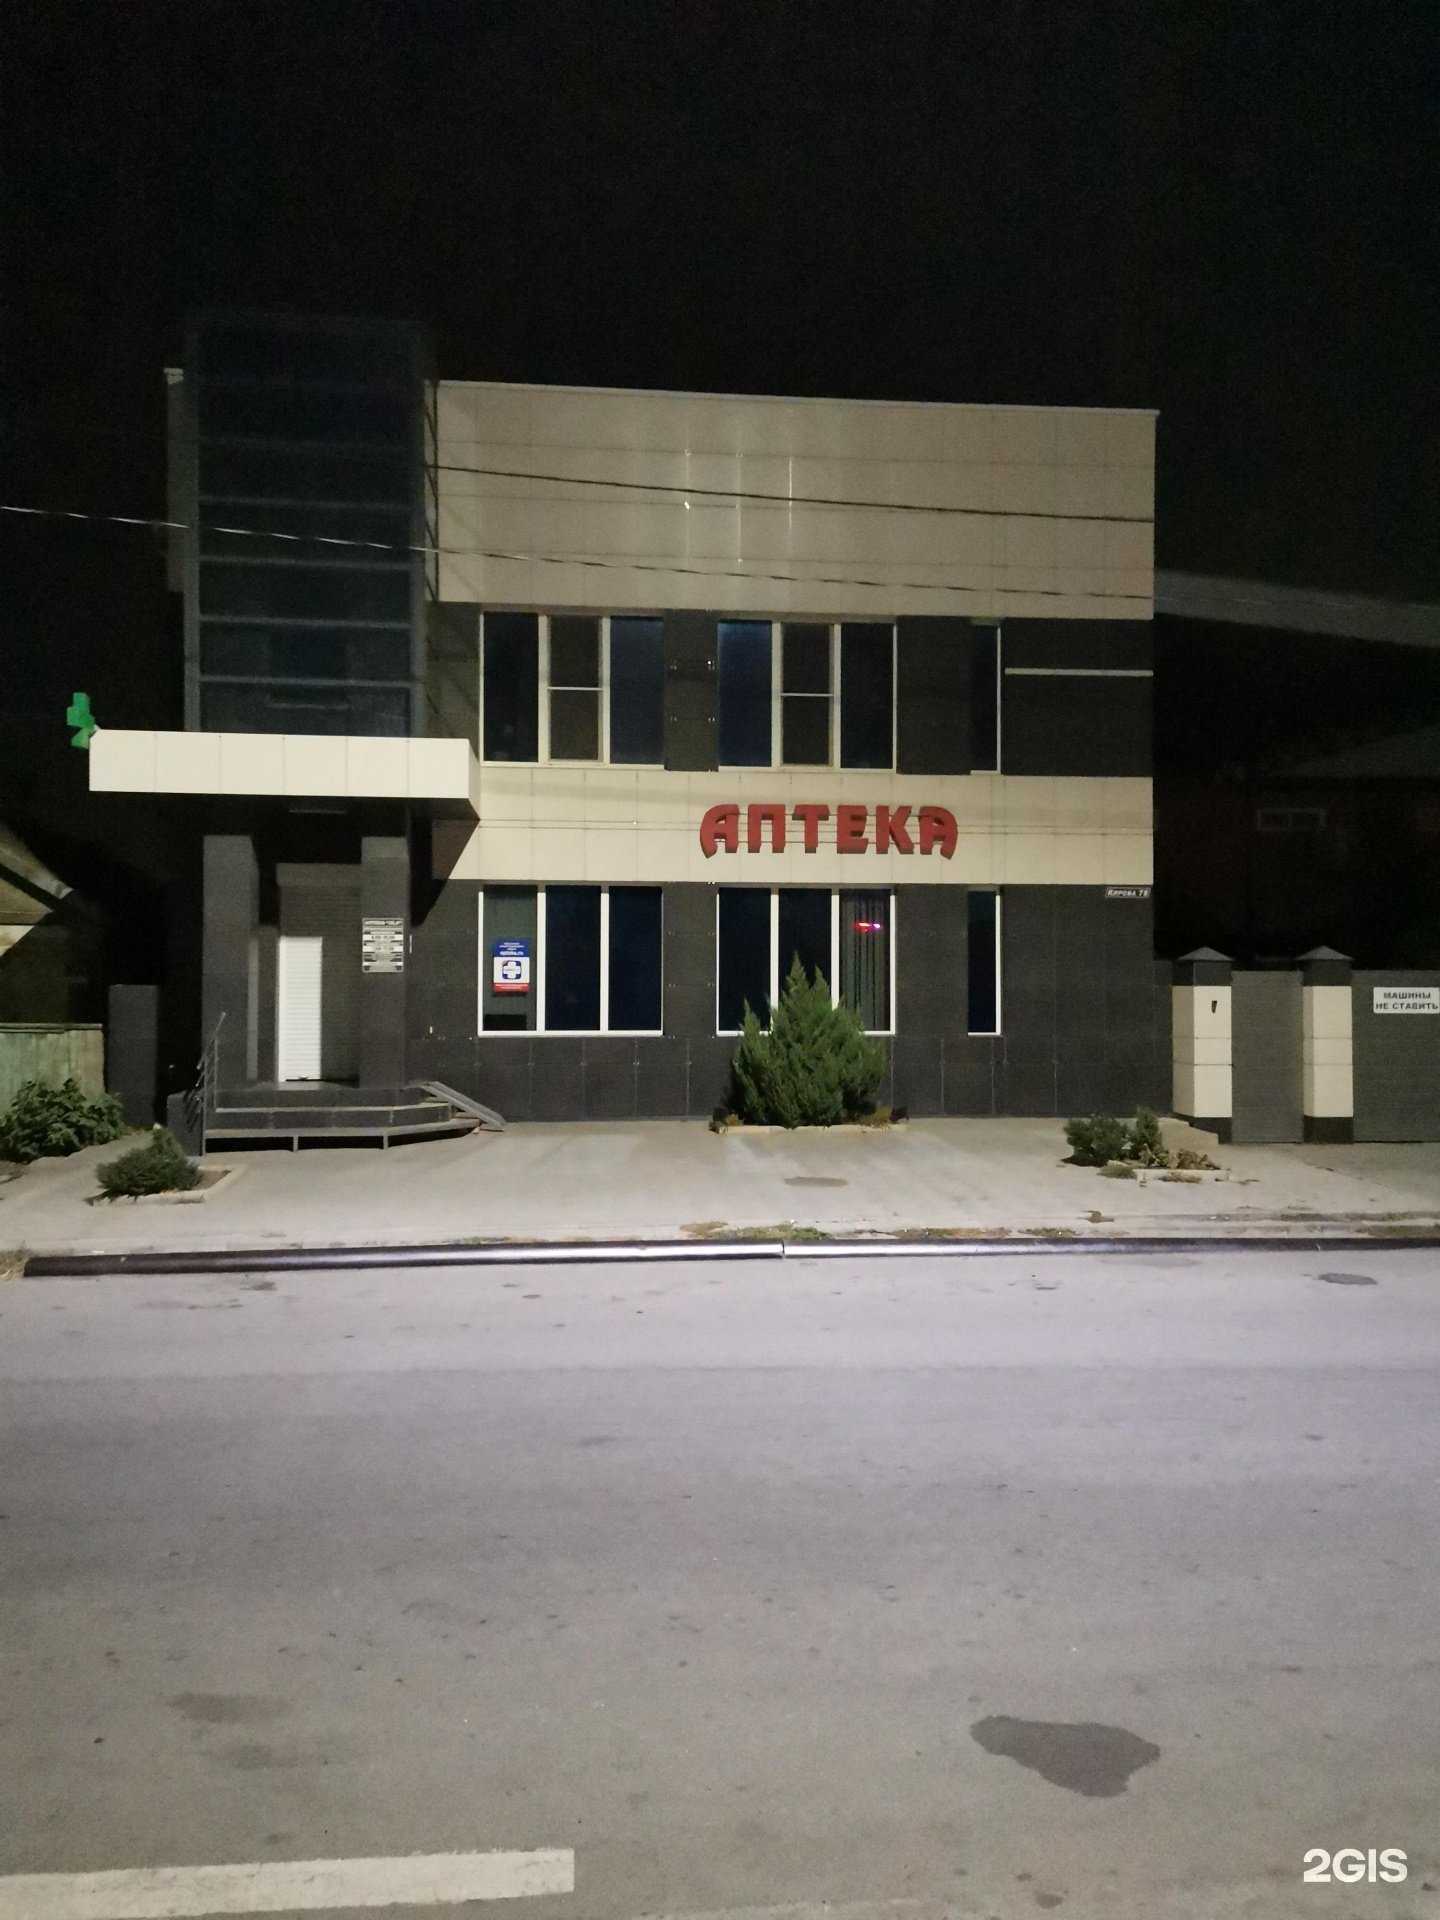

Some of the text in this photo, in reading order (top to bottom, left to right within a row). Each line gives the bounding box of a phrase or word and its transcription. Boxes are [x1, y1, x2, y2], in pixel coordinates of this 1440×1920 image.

[700, 804, 958, 860] АПТЕКА
[1383, 991, 1431, 999] МАШИНЫ
[1376, 1002, 1439, 1010] НЕ СТАВИТЬ
